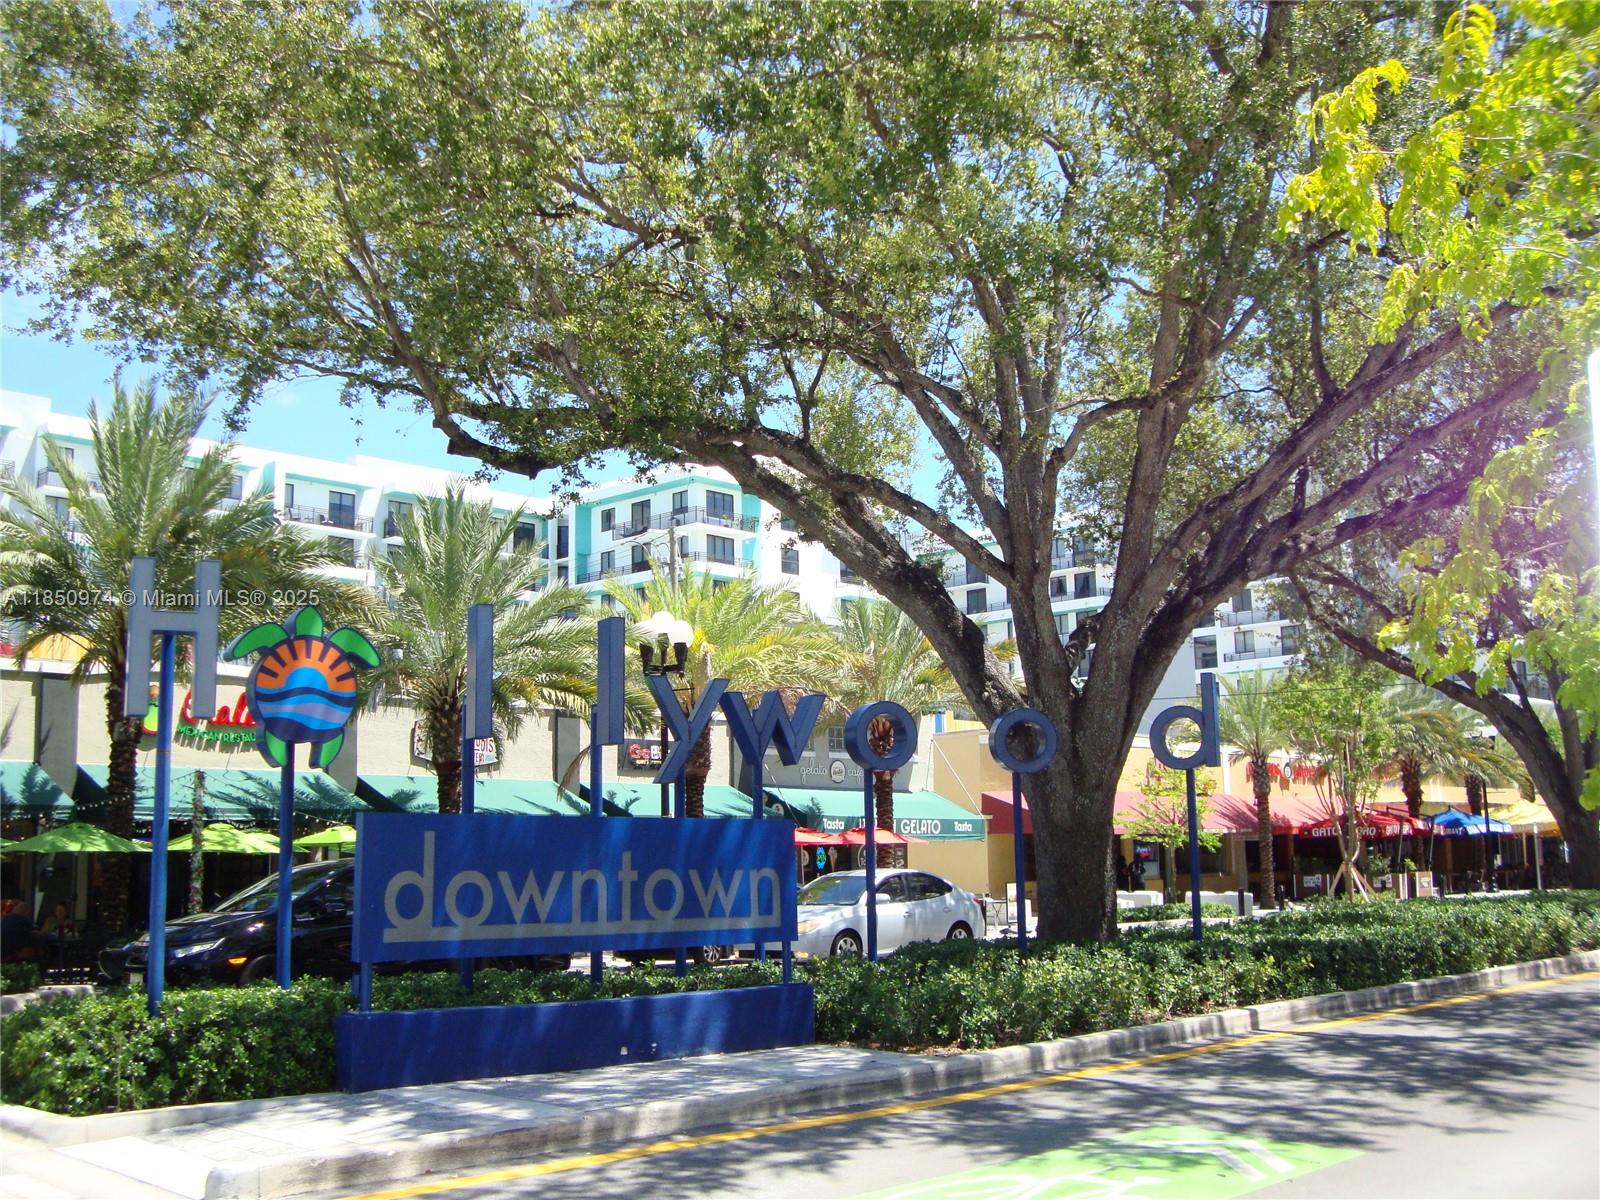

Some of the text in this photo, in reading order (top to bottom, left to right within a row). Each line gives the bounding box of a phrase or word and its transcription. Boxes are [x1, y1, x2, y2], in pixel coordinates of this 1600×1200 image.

[223, 731, 256, 742] RESTAU
[800, 758, 828, 785] gelato
[823, 818, 845, 830] Tasta
[900, 819, 942, 835] GELATO
[954, 821, 973, 832] Tasta
[383, 830, 782, 940] downtown
